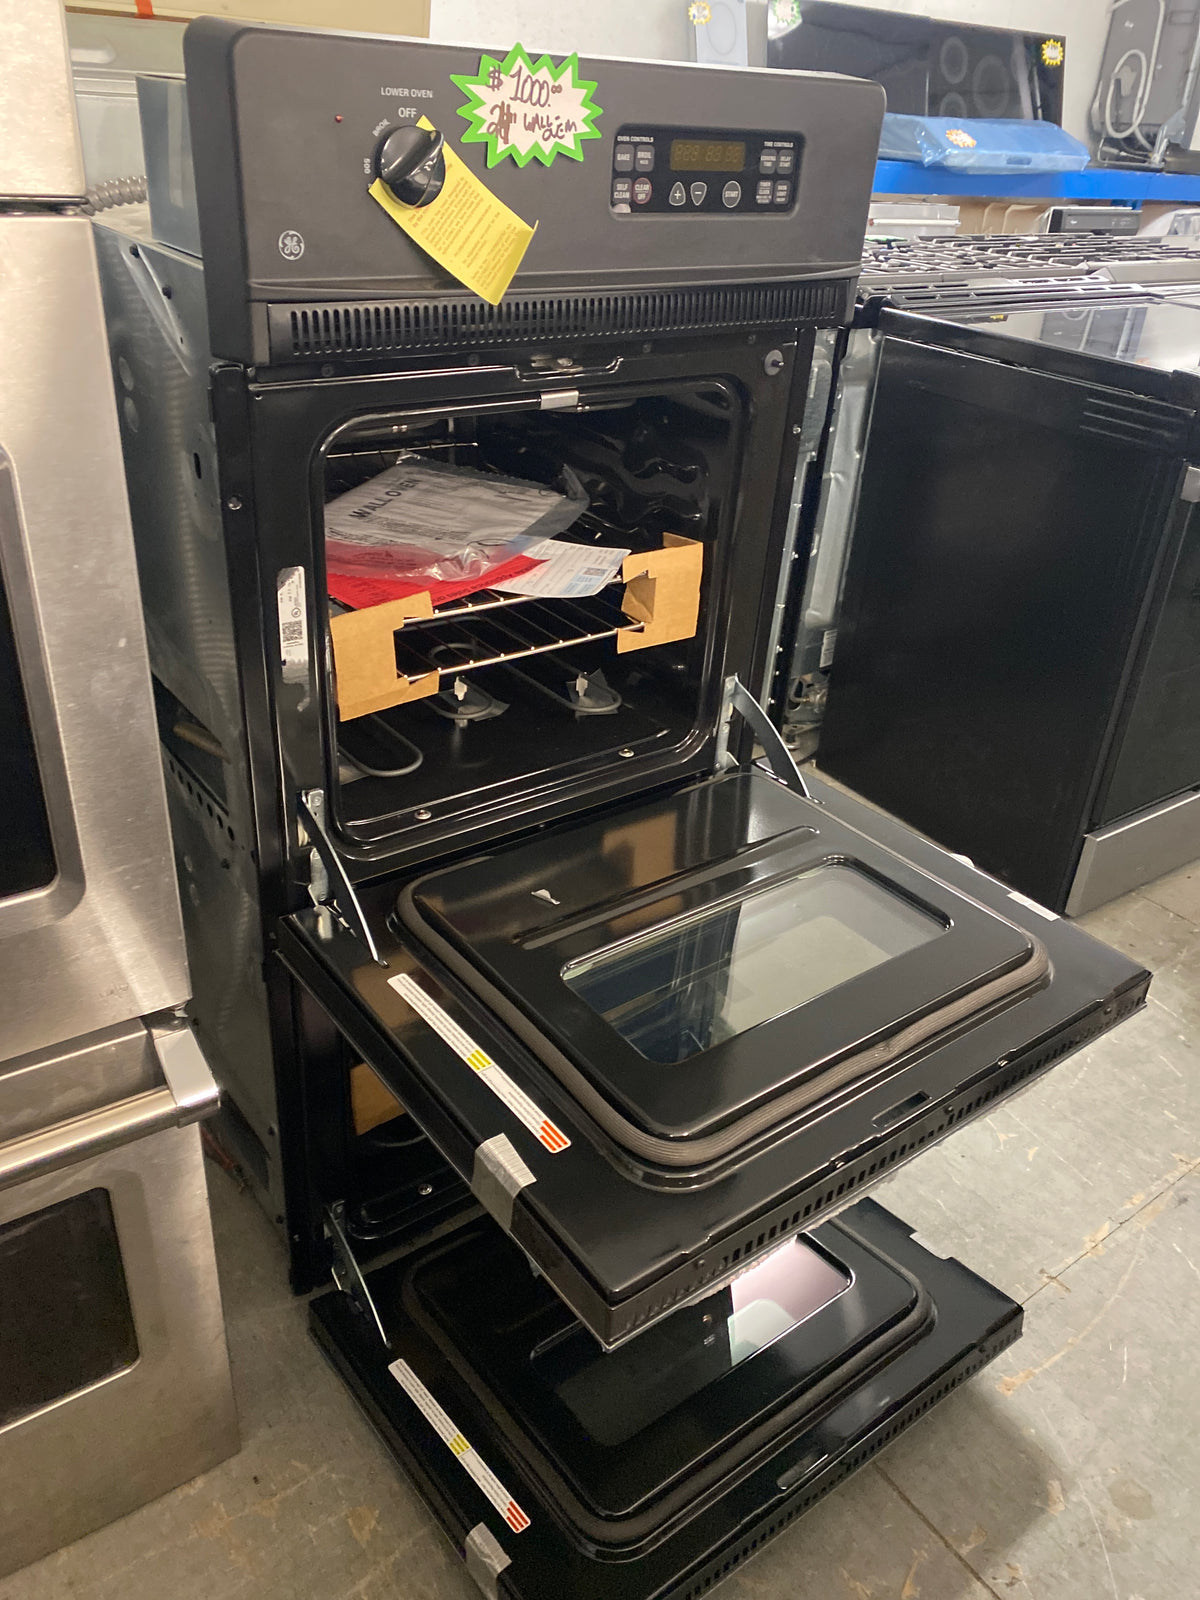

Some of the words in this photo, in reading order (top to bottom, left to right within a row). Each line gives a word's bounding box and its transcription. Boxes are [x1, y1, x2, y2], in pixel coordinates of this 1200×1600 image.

[380, 87, 409, 97] LOWER
[410, 89, 433, 98] OVEN
[398, 107, 417, 118] OFF
[348, 498, 393, 520] WALL
